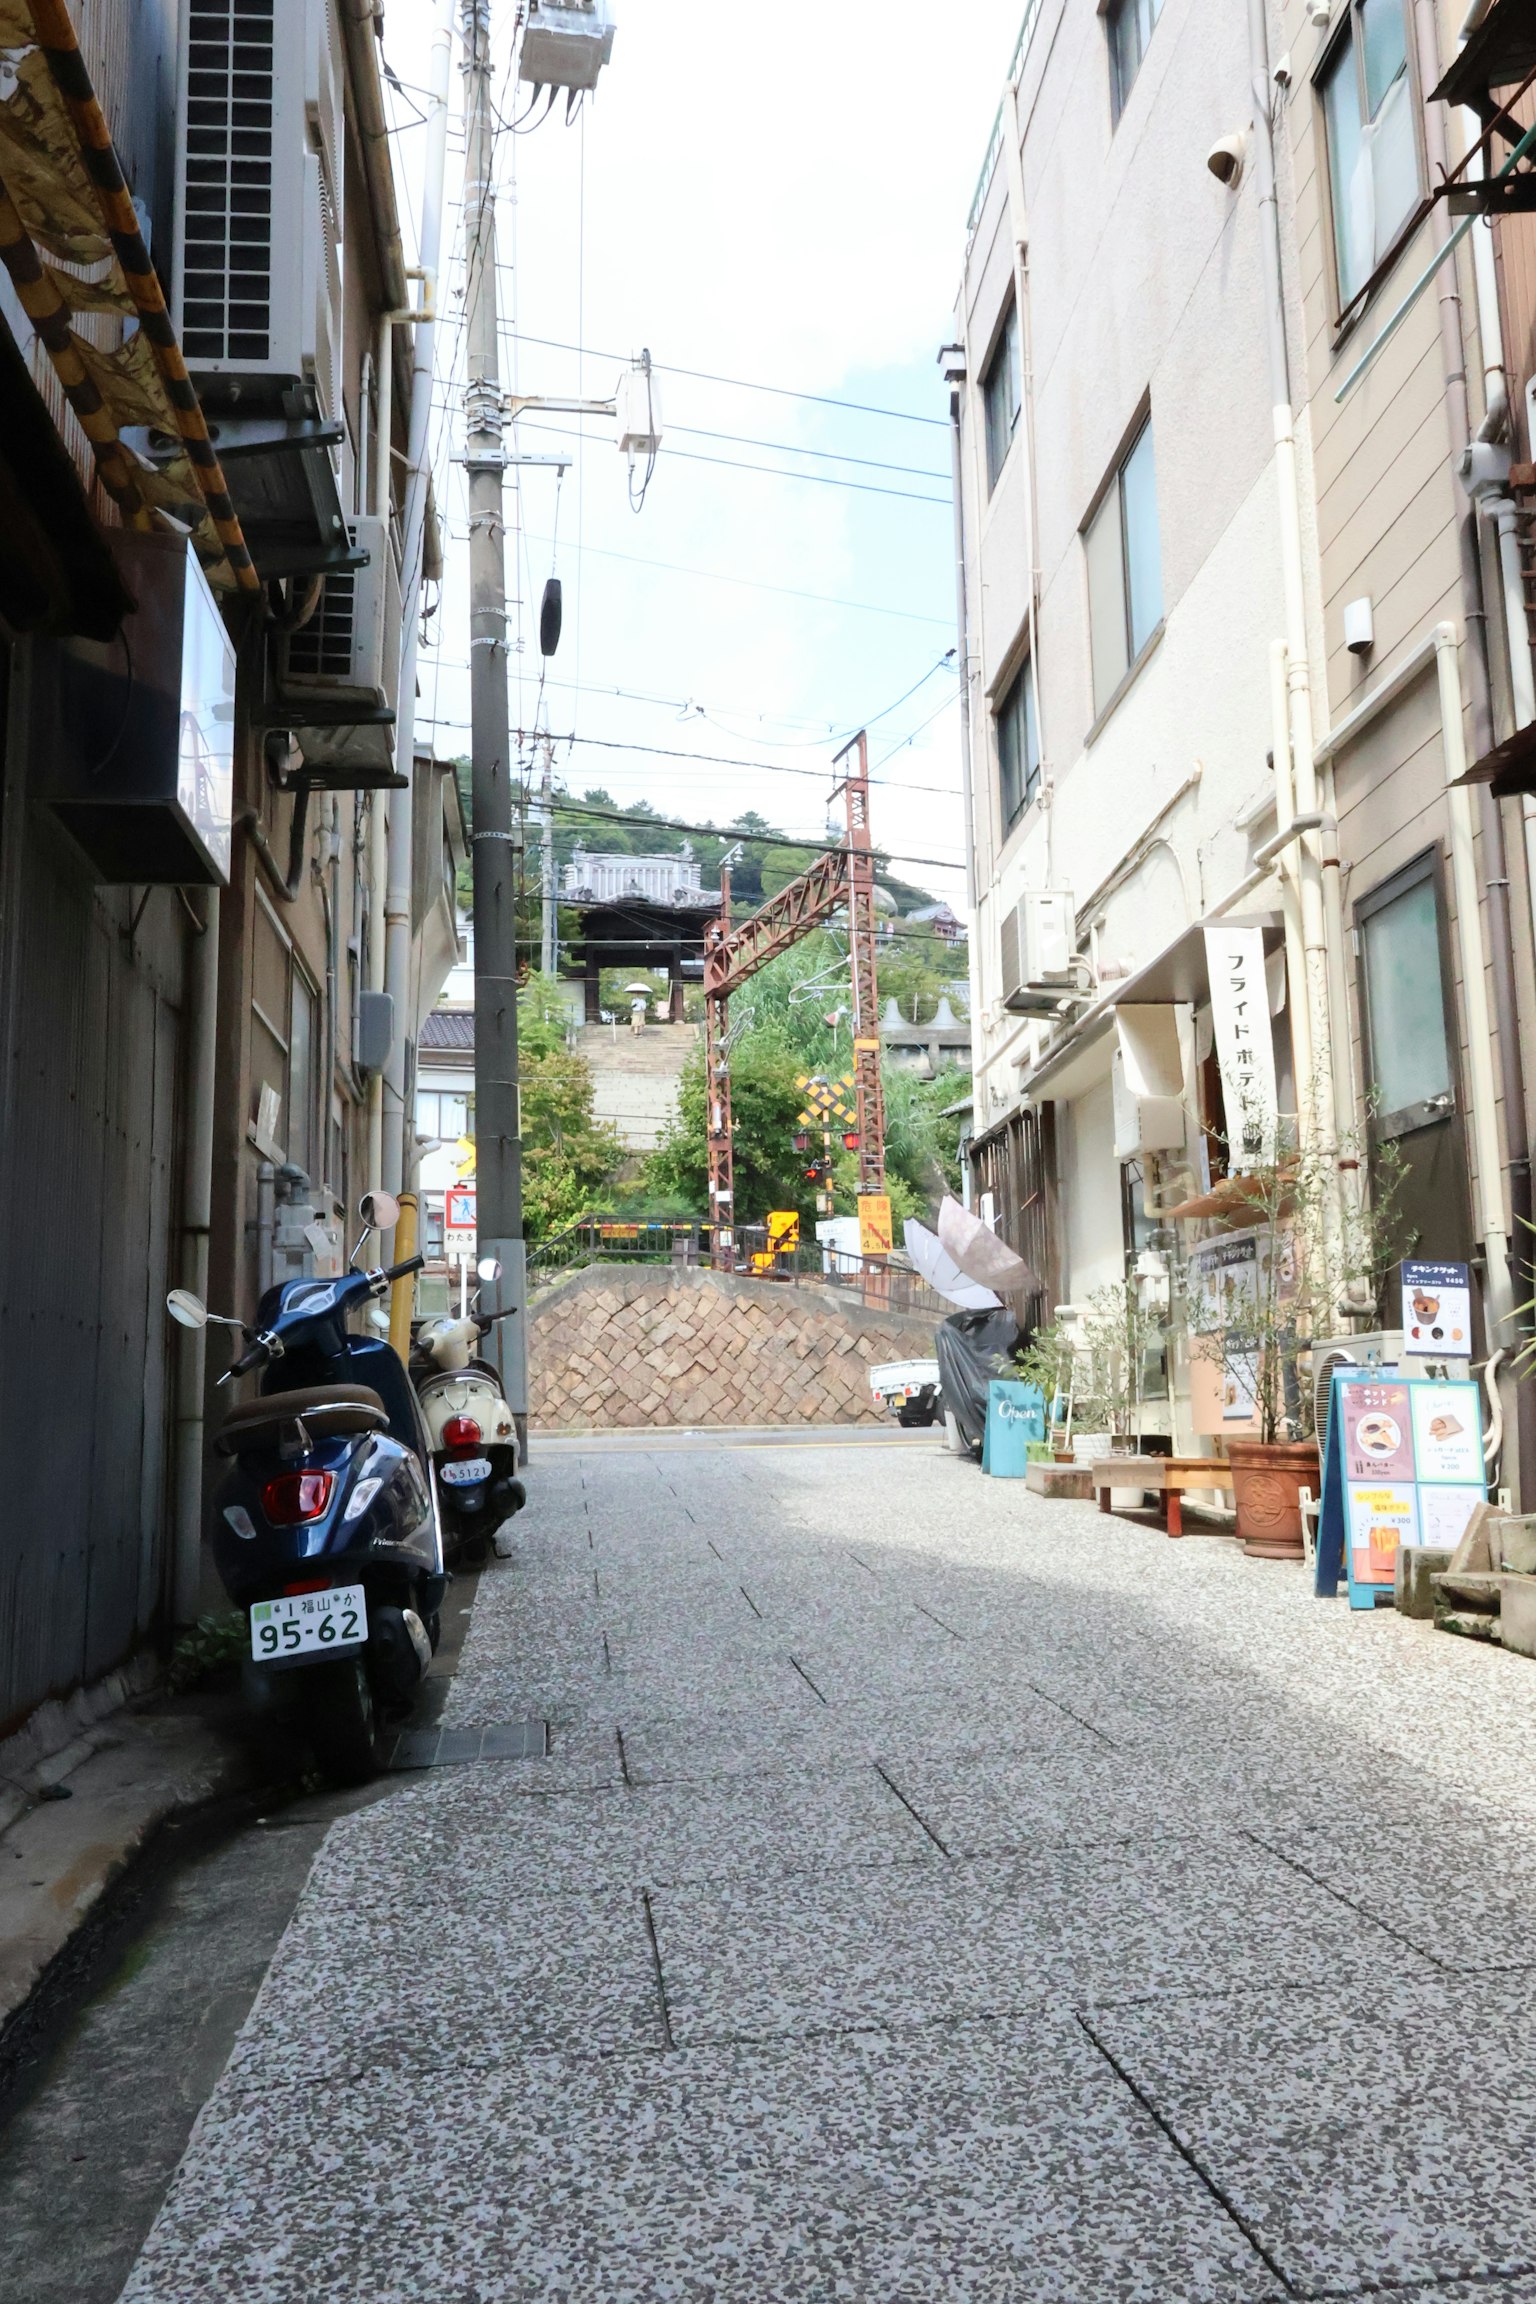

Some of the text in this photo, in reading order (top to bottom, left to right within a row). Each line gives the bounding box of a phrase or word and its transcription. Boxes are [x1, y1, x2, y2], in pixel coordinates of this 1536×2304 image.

[1227, 954, 1255, 1111] フライドポテト
[861, 1200, 888, 1212] 危険
[447, 1233, 473, 1241] わたる
[1411, 1265, 1458, 1274] チキンナゲット
[998, 1399, 1038, 1424] Open
[459, 1466, 486, 1479] 5121
[344, 1593, 356, 1606] か
[259, 1610, 359, 1654] 95-62
